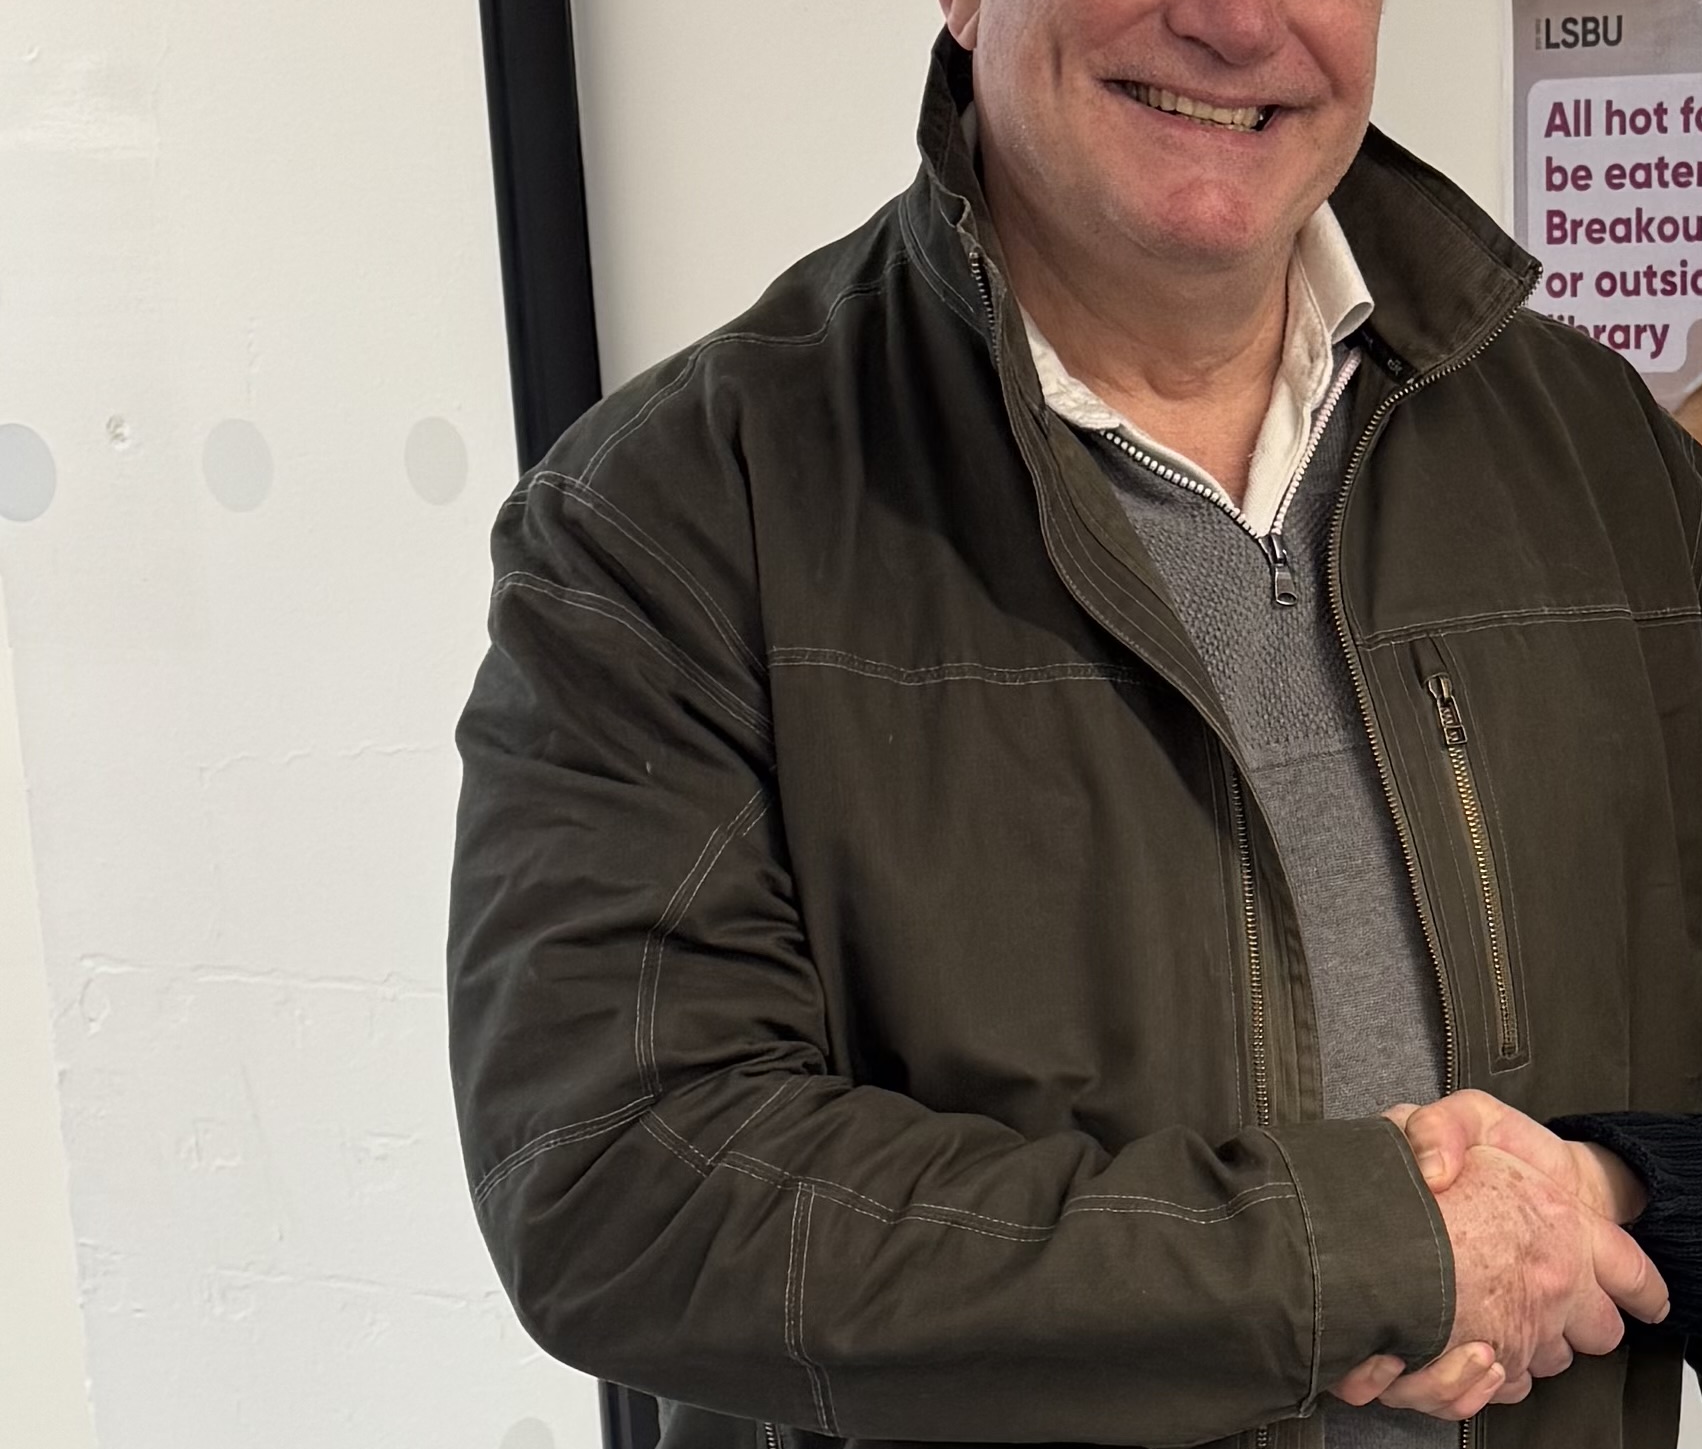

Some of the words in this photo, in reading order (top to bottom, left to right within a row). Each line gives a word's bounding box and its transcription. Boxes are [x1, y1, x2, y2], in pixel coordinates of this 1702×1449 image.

[1545, 14, 1623, 50] LSBU
[1543, 98, 1593, 139] All
[1604, 99, 1669, 137] hot
[1544, 156, 1593, 192] be
[1544, 270, 1584, 299] or
